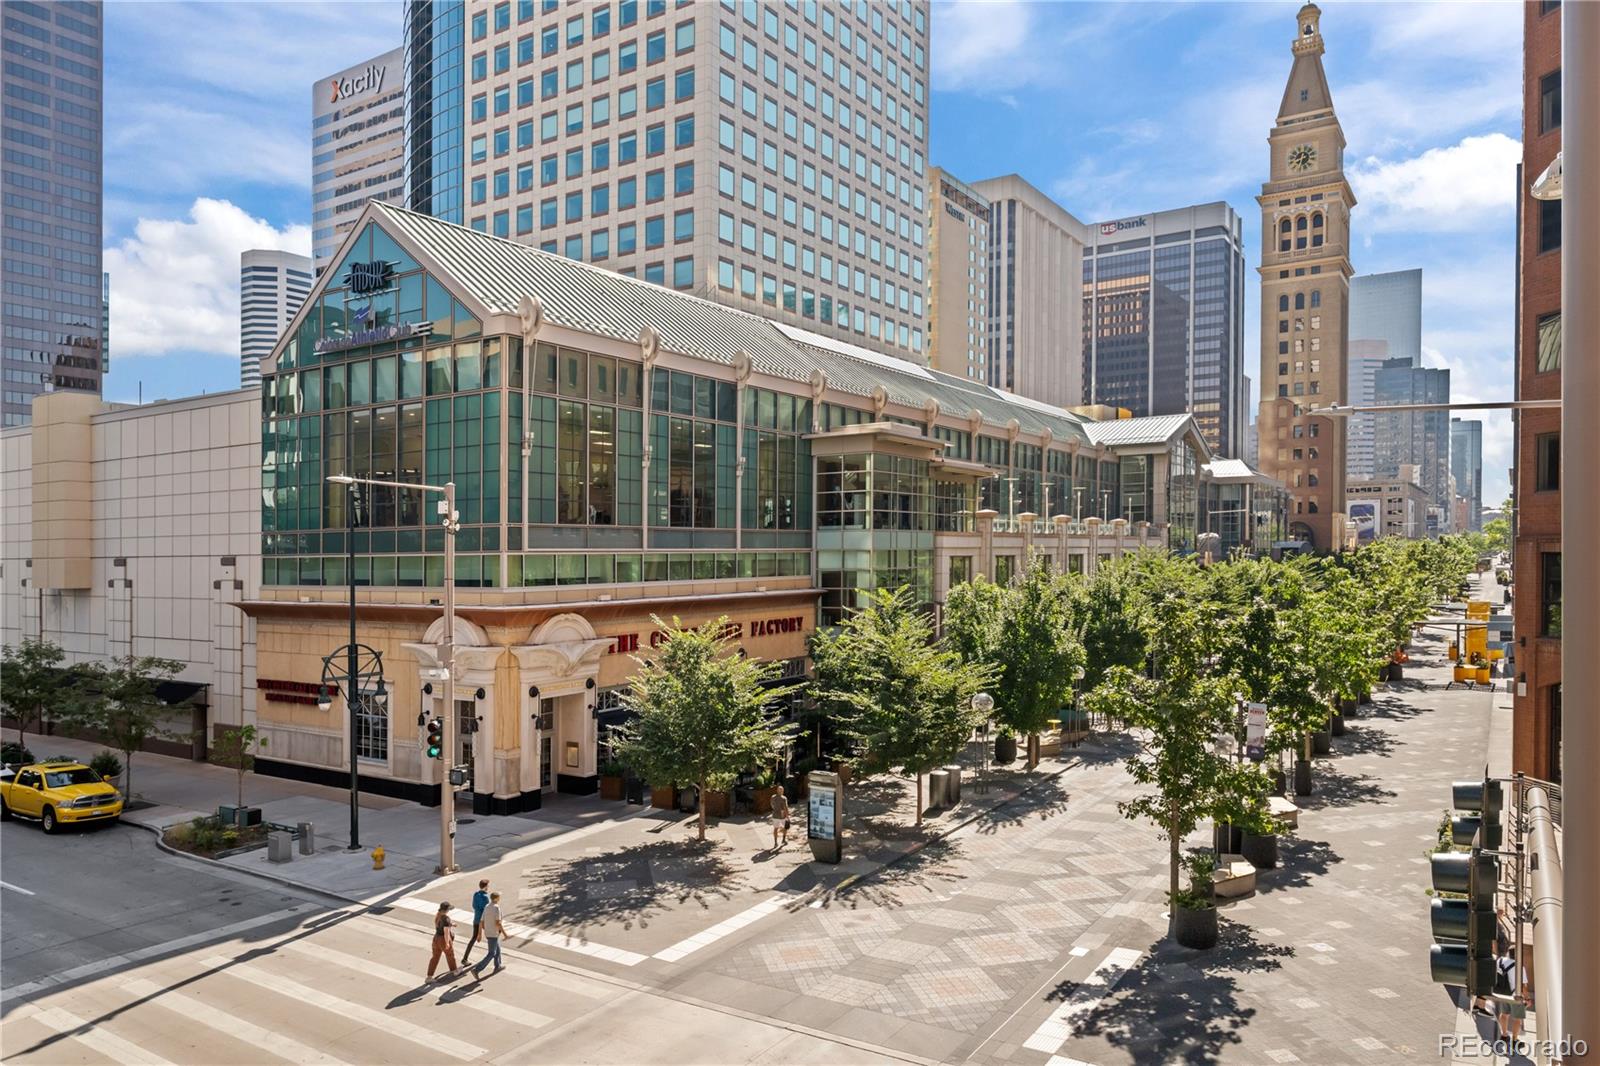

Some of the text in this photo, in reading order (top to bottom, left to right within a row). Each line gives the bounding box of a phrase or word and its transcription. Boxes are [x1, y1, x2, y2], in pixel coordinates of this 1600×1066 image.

[330, 64, 386, 103] Xactly
[349, 260, 391, 294] TABOR
[750, 616, 804, 637] FACTORY
